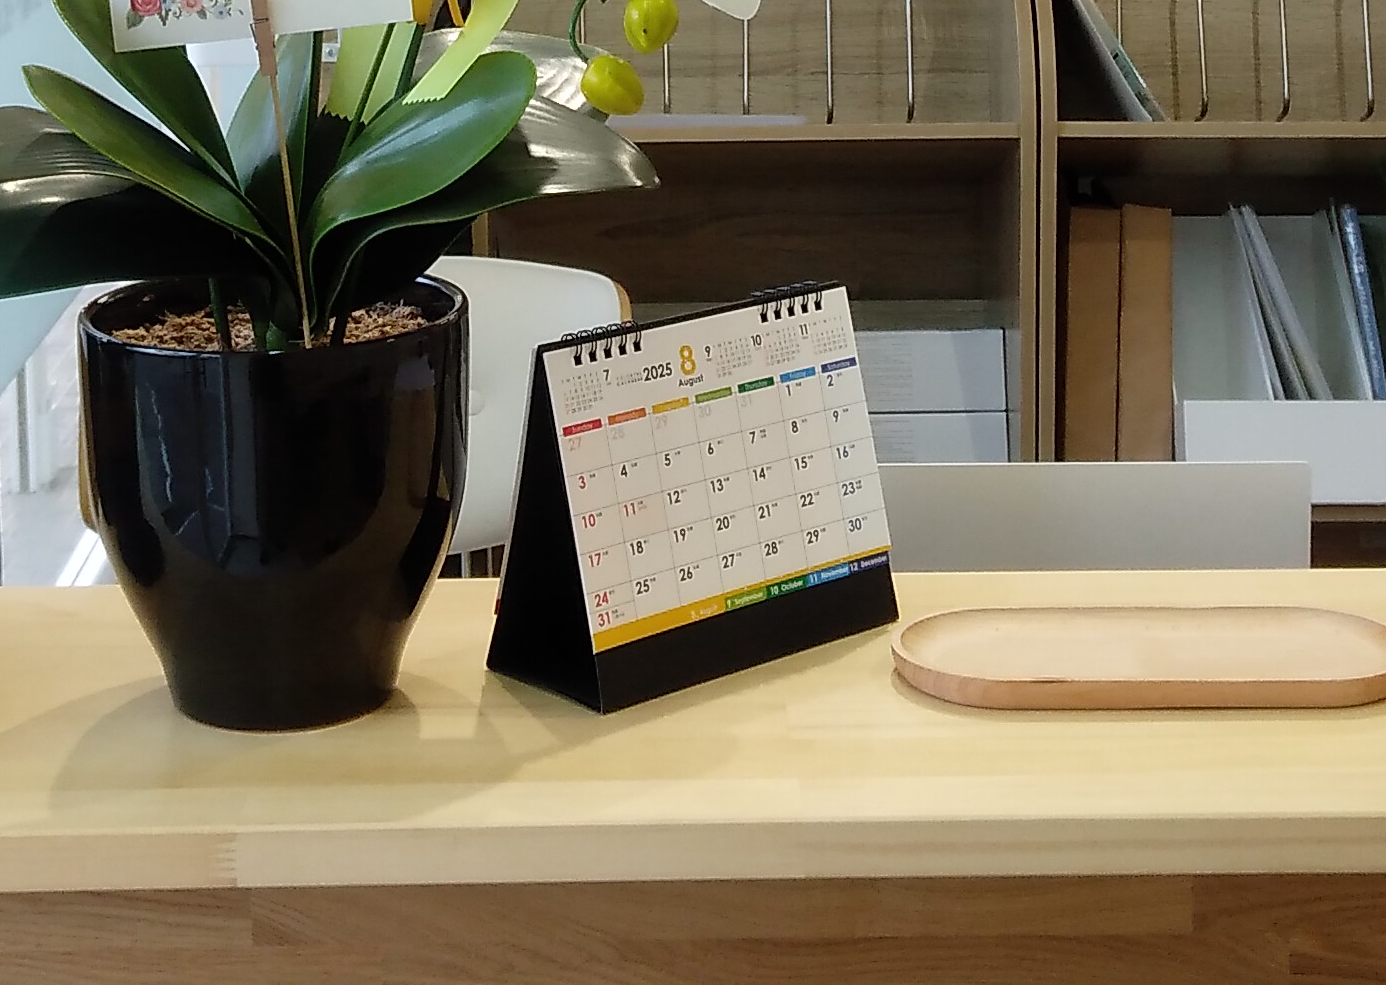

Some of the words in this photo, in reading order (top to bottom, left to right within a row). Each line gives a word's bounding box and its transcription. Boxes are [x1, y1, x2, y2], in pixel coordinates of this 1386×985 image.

[799, 324, 808, 335] 11
[751, 335, 761, 346] 10
[705, 346, 710, 357] 9
[679, 346, 696, 375] 8
[603, 369, 609, 381] 7
[643, 362, 672, 381] 2025
[679, 372, 703, 387] August
[786, 385, 791, 396] 1
[827, 375, 834, 387] 2
[571, 422, 594, 433] Sunday
[579, 476, 586, 489] 3
[621, 465, 627, 477] 4
[665, 453, 671, 466] 5
[708, 443, 714, 455] 6
[749, 431, 755, 444] 7
[792, 421, 798, 433] 8
[833, 411, 838, 422] 9
[582, 514, 595, 528] 10
[624, 503, 635, 517] 11
[667, 490, 681, 505] 12
[710, 479, 723, 493] 13
[753, 467, 765, 481] 14
[795, 456, 807, 470] 15
[836, 446, 848, 459] 16
[589, 553, 601, 567] 17
[630, 541, 643, 555] 18
[674, 529, 685, 543] 19
[716, 516, 729, 531] 20
[758, 505, 771, 519] 21
[800, 493, 814, 507] 22
[842, 482, 855, 496] 23
[595, 592, 608, 607] 24
[636, 579, 649, 595] 25
[679, 567, 693, 581] 26
[722, 554, 734, 568] 27
[764, 542, 778, 556] 28
[806, 530, 819, 544] 29
[849, 518, 861, 532] 30
[849, 563, 859, 572] 12
[860, 555, 888, 568] December
[810, 574, 818, 583] 11
[821, 566, 848, 580] November
[769, 585, 779, 595] 10
[781, 579, 803, 592] October
[734, 592, 763, 606] September
[598, 612, 610, 627] 31
